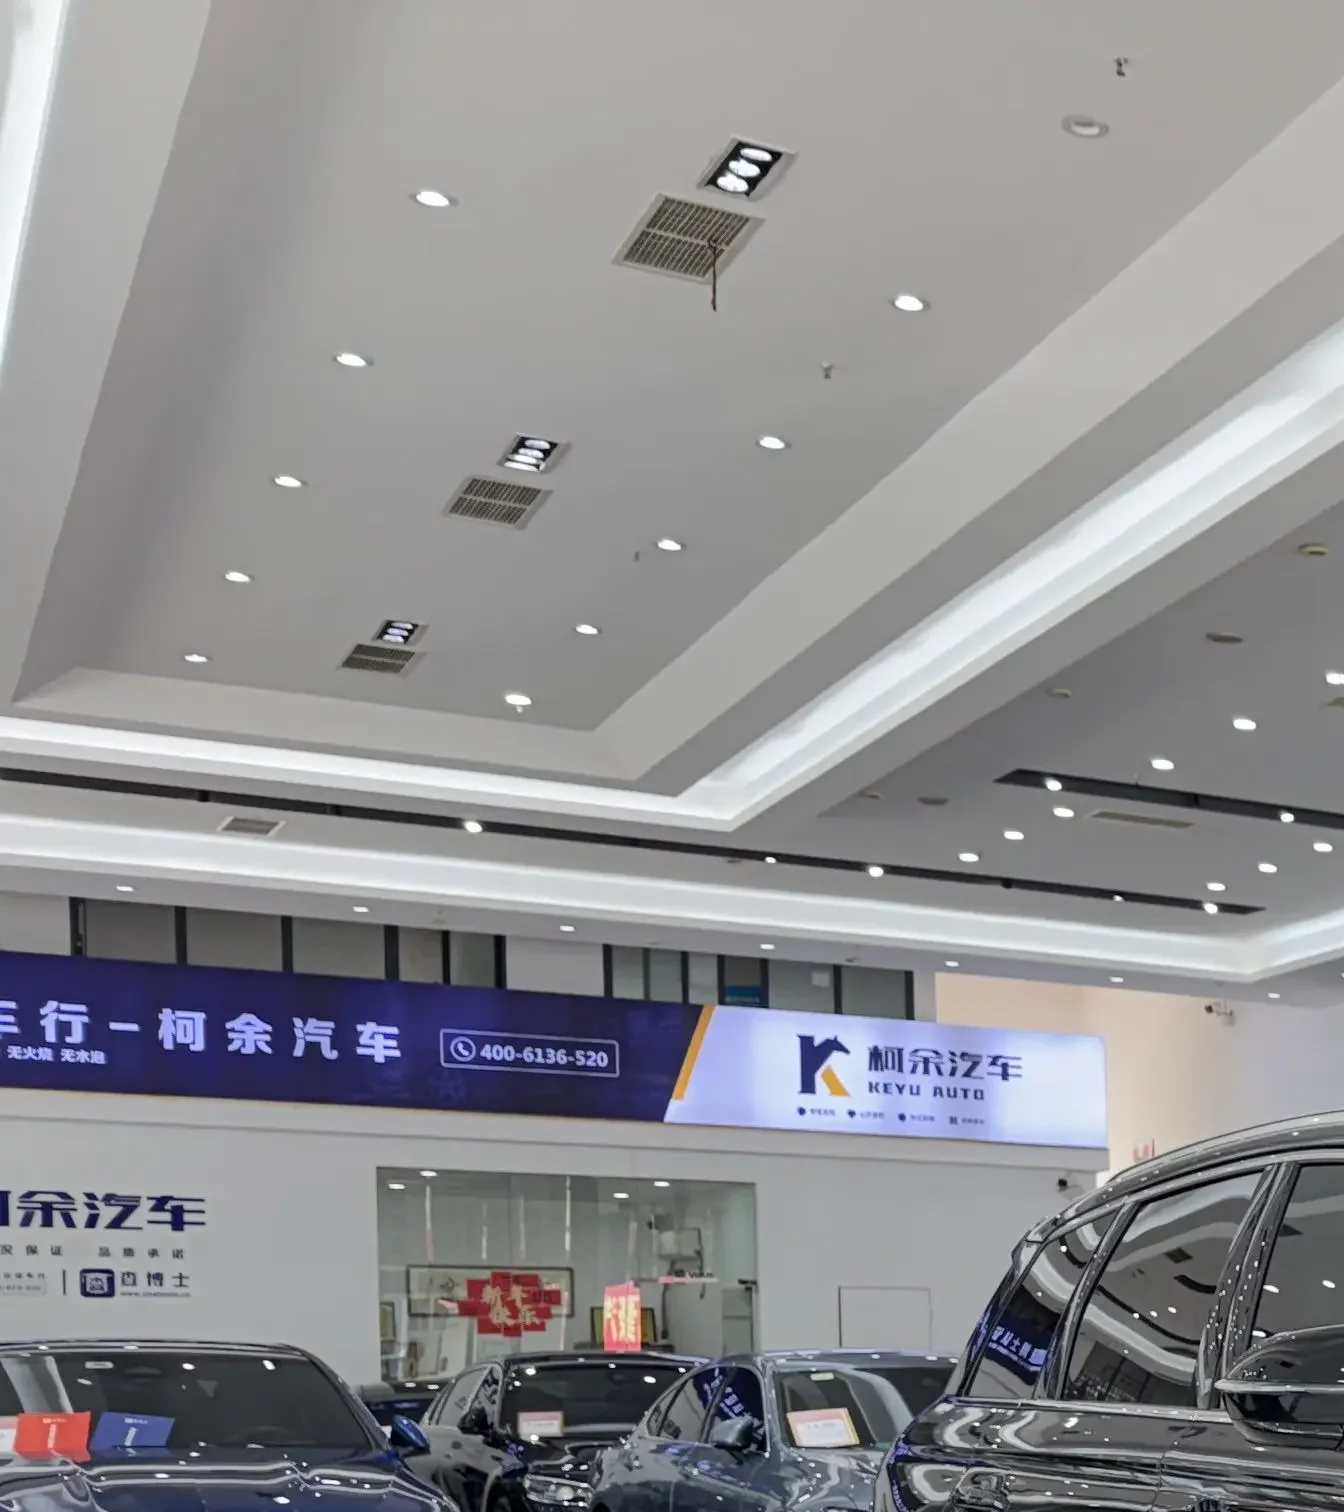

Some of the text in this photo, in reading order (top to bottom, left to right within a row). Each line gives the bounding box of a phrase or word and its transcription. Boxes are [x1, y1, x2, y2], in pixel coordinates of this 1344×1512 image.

[480, 1044, 609, 1069] 400-6136-520
[868, 1044, 1023, 1082] 柯余汽车
[868, 1081, 985, 1101] KEYU AUTO
[0, 1190, 206, 1232] 余汽车
[98, 1247, 185, 1260] 品质承诺
